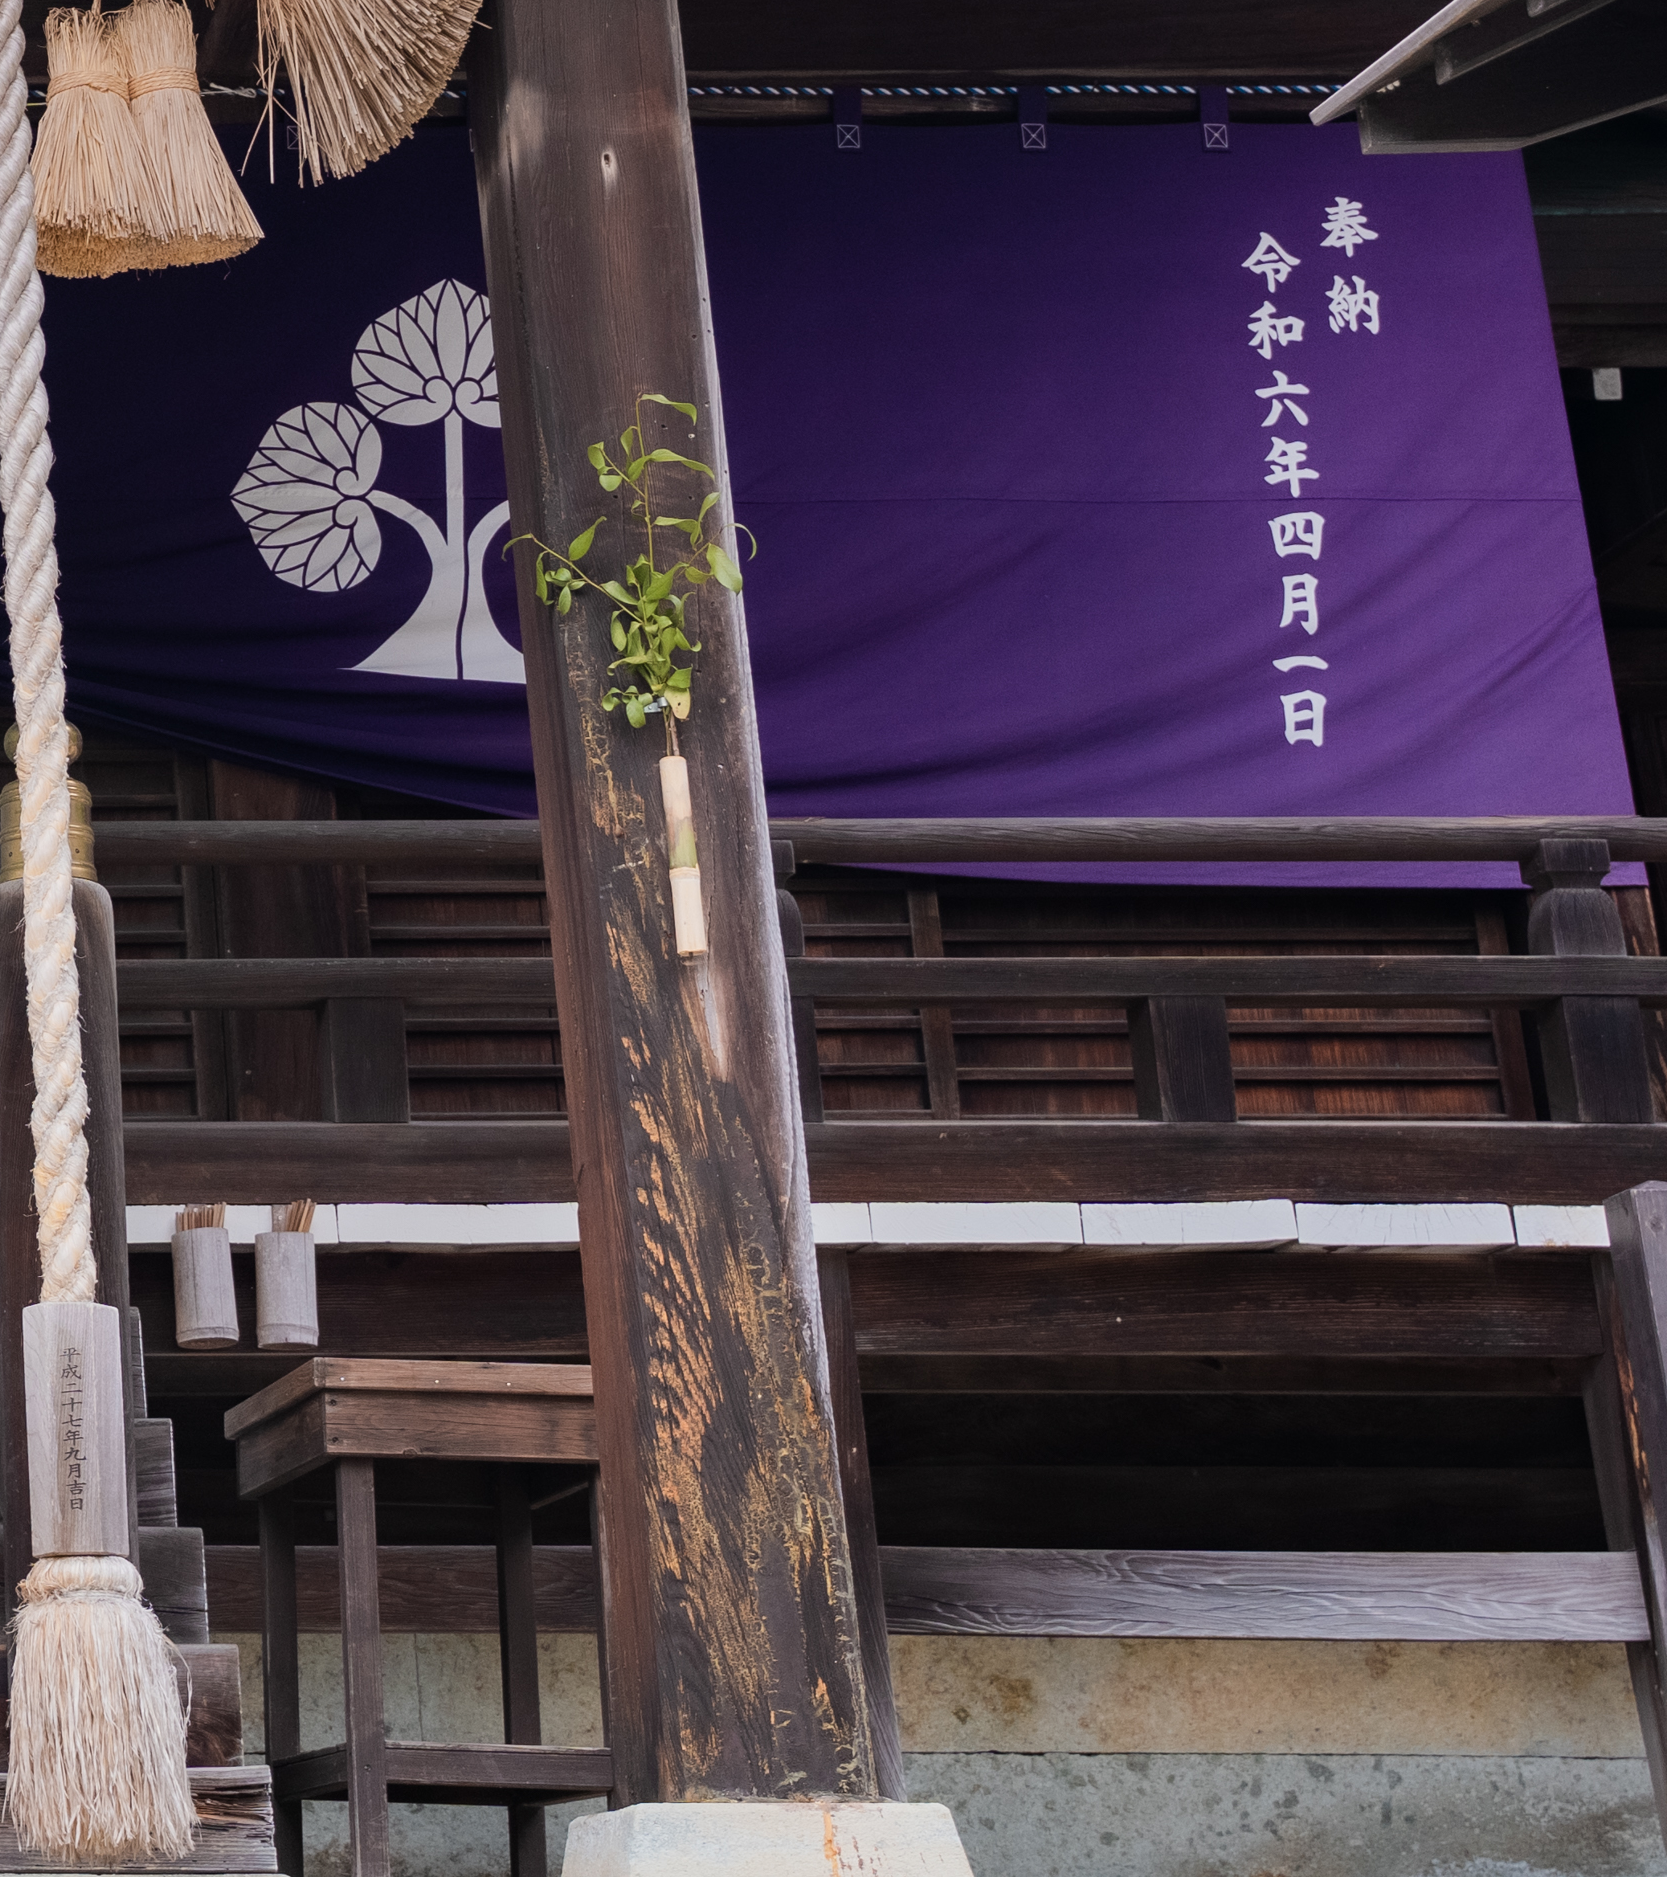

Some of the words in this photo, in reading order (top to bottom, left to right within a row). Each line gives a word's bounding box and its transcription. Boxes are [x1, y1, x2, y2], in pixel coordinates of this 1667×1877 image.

[1320, 196, 1380, 334] 奉納
[1241, 231, 1329, 748] 令和六年四月一日
[60, 1347, 87, 1511] 平成二十七年九月吉日
